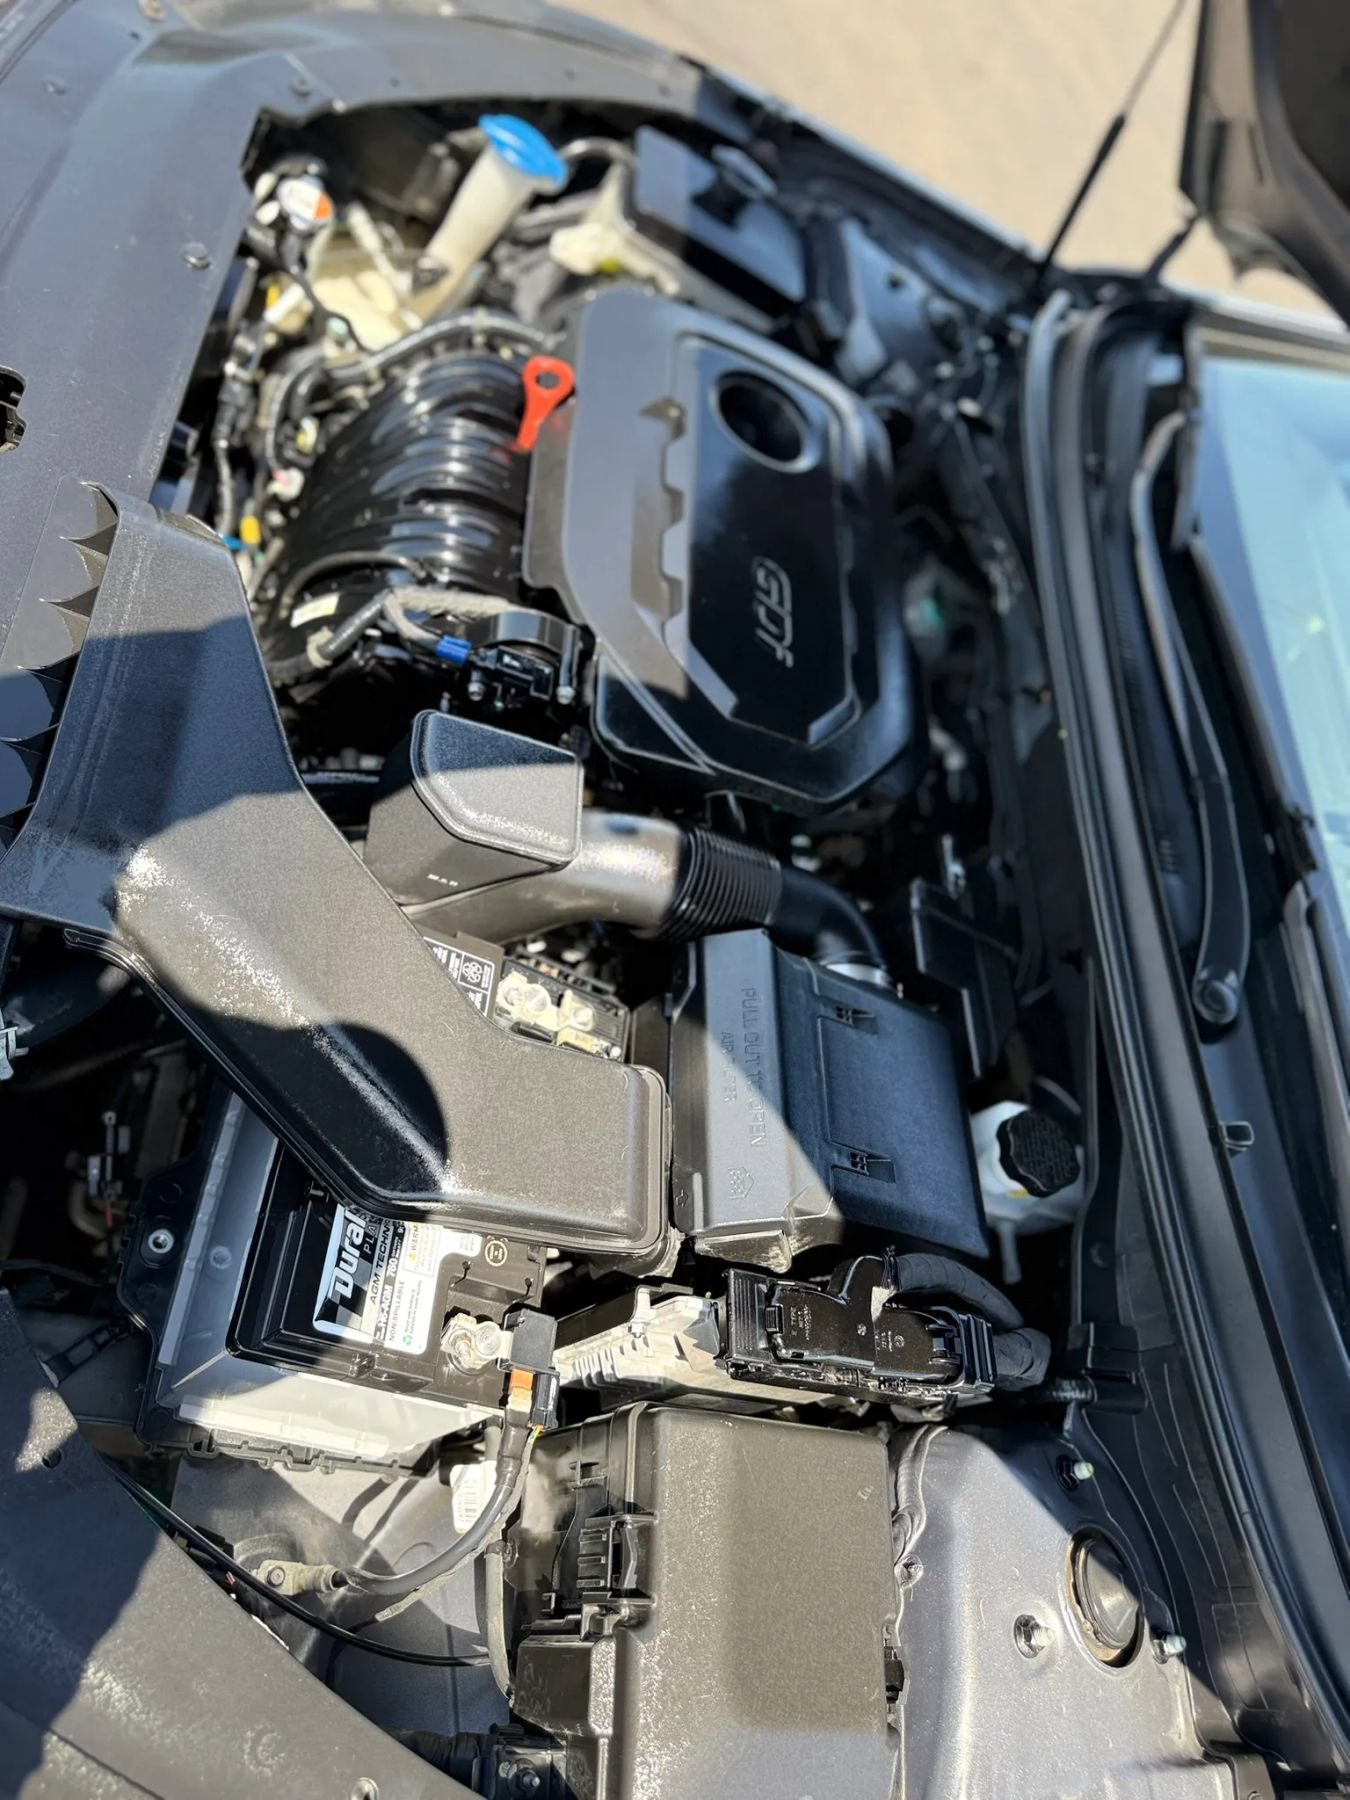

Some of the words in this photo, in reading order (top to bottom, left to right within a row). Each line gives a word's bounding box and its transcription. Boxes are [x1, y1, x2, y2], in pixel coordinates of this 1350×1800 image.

[741, 987, 759, 1028] PULL
[721, 1031, 735, 1053] AIR
[744, 1032, 762, 1063] OUT
[746, 1073, 763, 1092] TO
[749, 1098, 767, 1147] OPEN
[327, 1208, 366, 1299] Dural
[363, 1223, 377, 1255] PLA
[375, 1224, 393, 1272] TECHN
[370, 1273, 381, 1305] AGM
